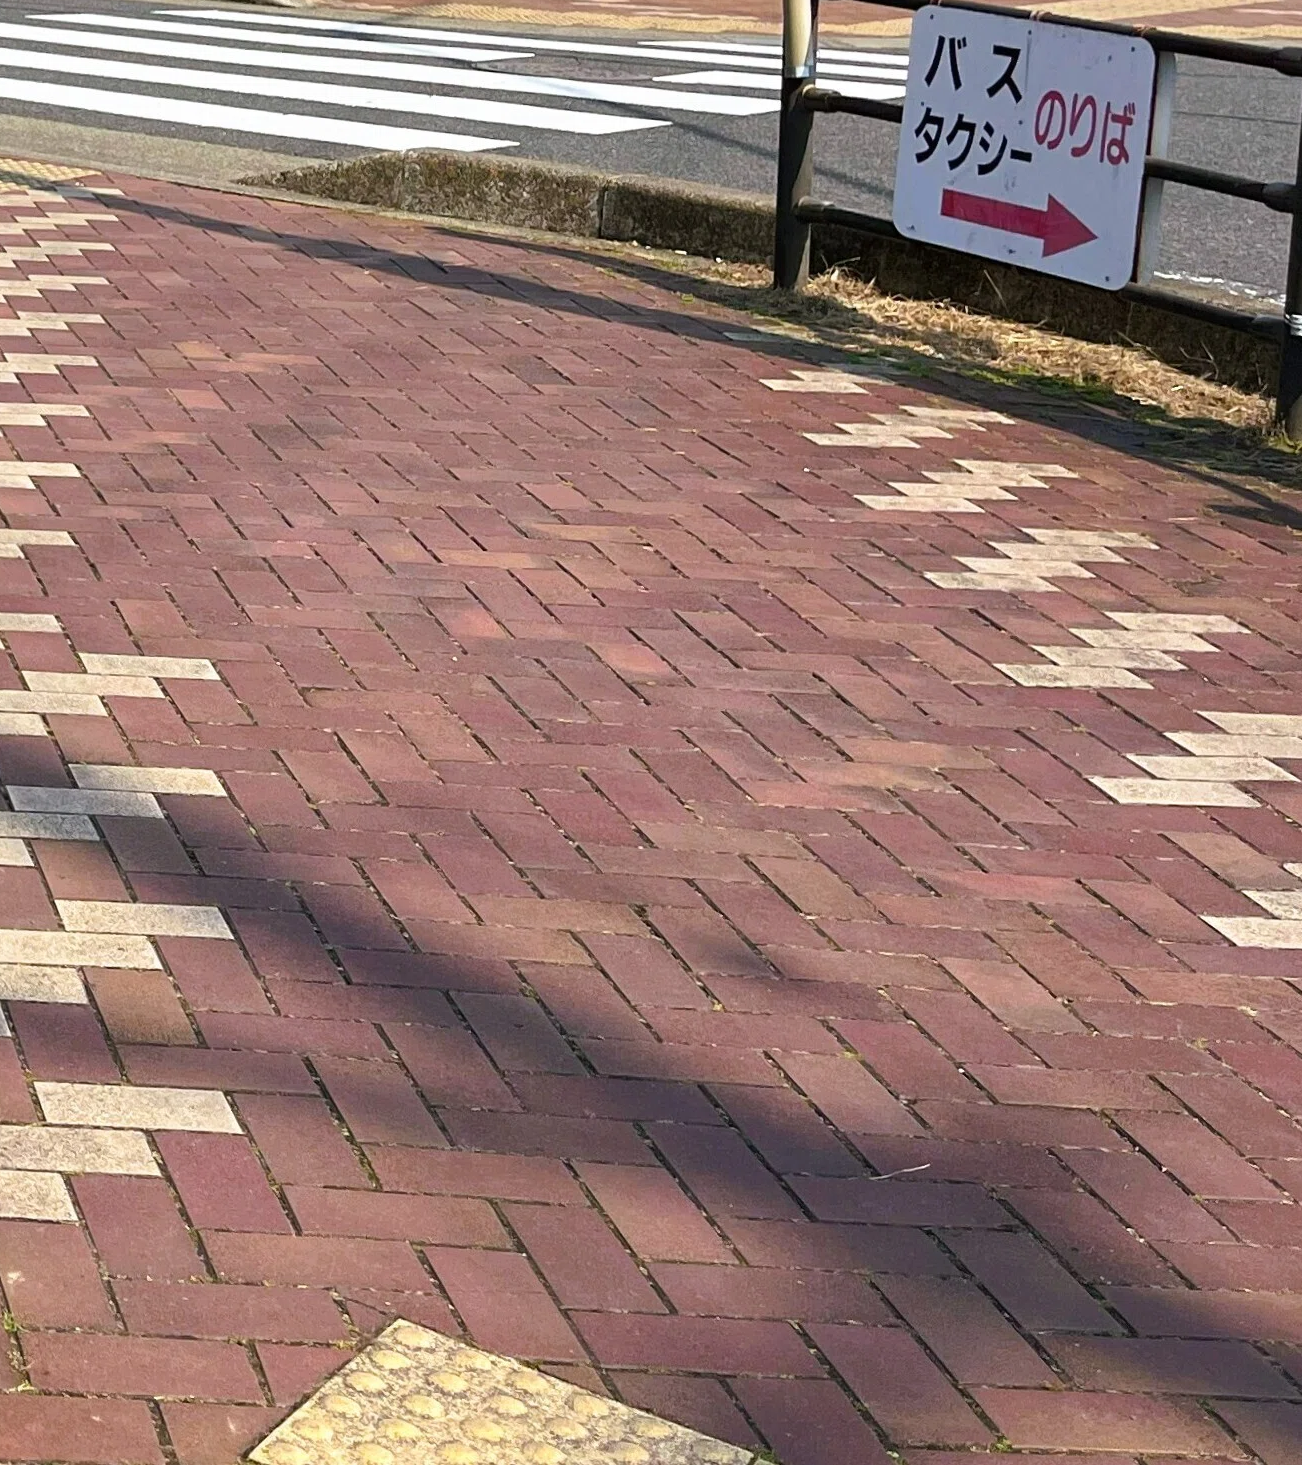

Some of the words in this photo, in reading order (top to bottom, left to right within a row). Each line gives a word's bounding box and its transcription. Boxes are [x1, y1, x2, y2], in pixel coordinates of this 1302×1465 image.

[923, 34, 1023, 105] バス
[913, 106, 1033, 176] タクシー
[1033, 89, 1136, 167] のりば
